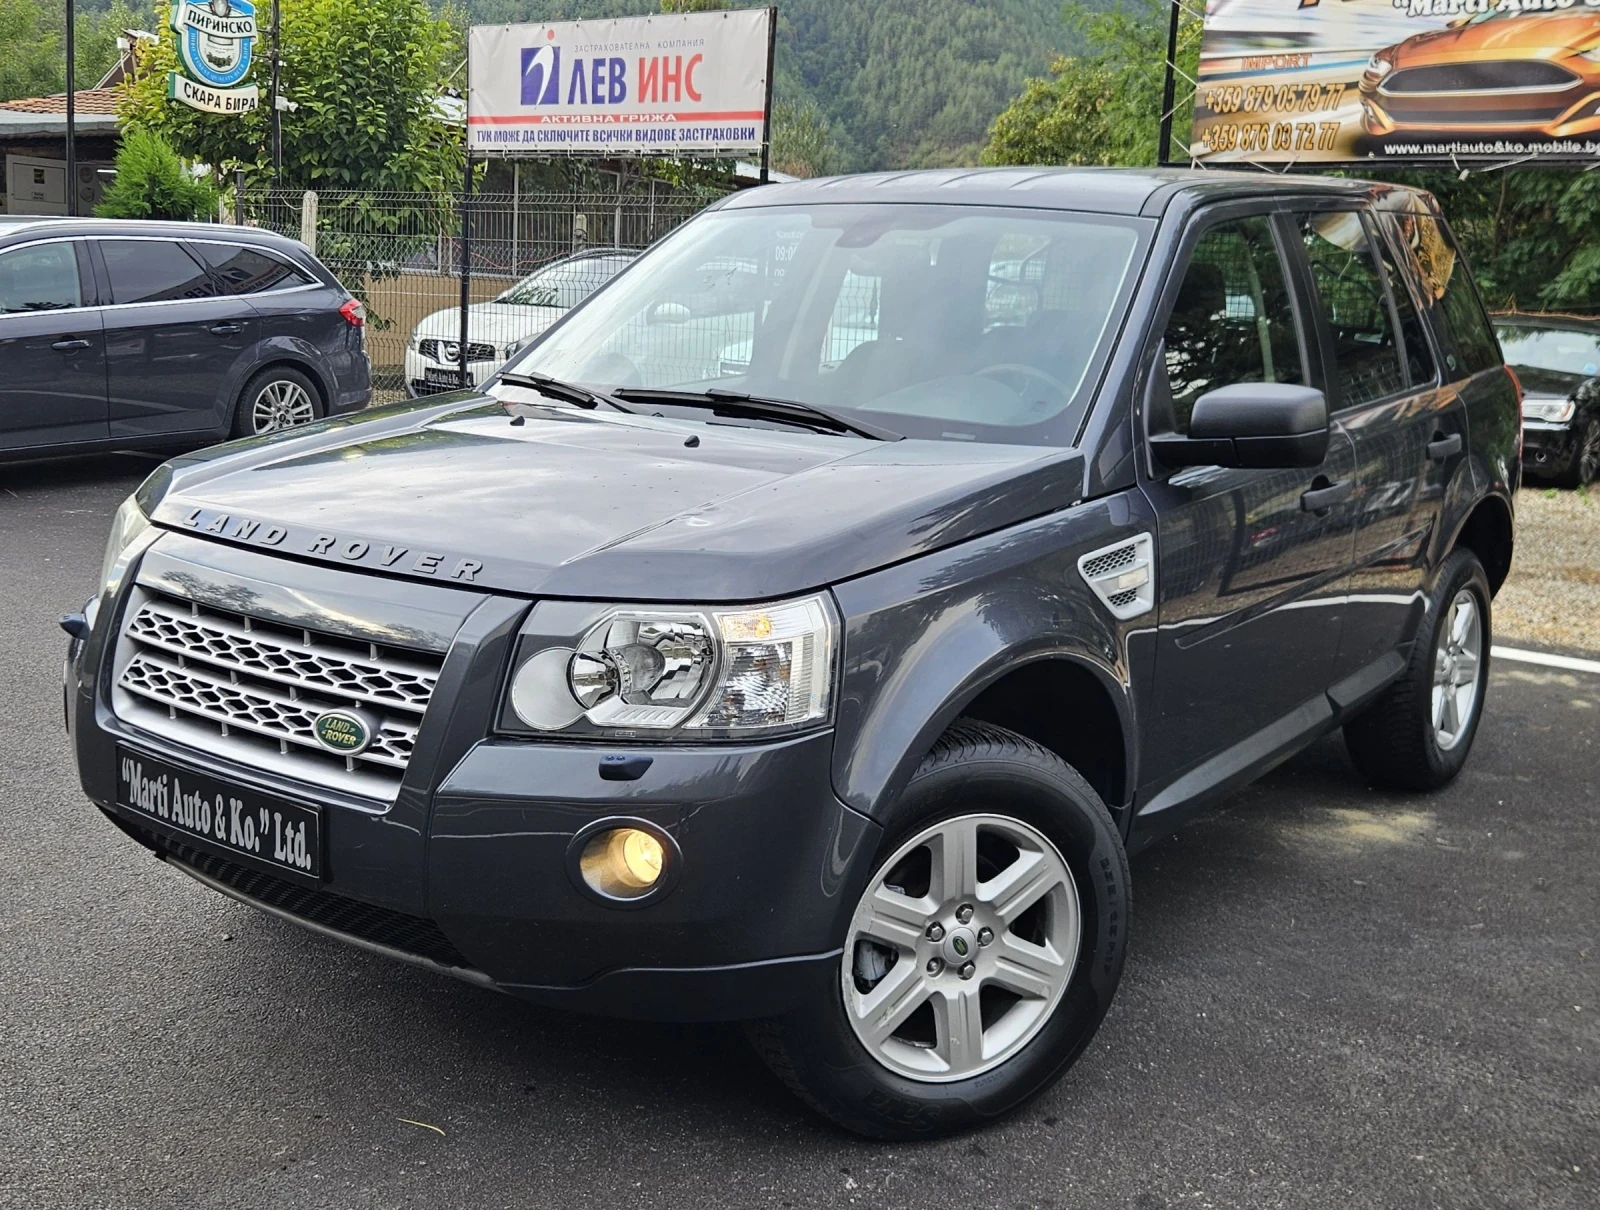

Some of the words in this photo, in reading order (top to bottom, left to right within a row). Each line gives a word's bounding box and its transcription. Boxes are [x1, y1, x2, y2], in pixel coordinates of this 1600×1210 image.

[187, 10, 253, 34] ПИРИНСКО
[574, 42, 650, 53] ЗАСТРАХОВАТЕЛНА
[657, 38, 705, 49] КОМПАНИЯ
[1241, 53, 1312, 71] IMPORT
[567, 57, 627, 105] ЛЕВ
[638, 53, 703, 104] ИНС
[183, 81, 221, 109] СКАРА
[225, 97, 256, 111] БИРА
[1205, 85, 1243, 114] +359
[1244, 85, 1275, 113] 879
[1276, 84, 1300, 113] 05
[1299, 83, 1321, 112] 79
[1323, 82, 1347, 111] 77
[541, 115, 615, 124] АКТИВНА
[619, 113, 677, 123] ГРИЖА
[477, 130, 492, 143] ТУК
[494, 130, 520, 143] МОЖЕ
[522, 130, 535, 144] ДА
[537, 129, 590, 143] СКЛЮЧИТЕ
[592, 128, 633, 142] ВСИЧКИ
[635, 128, 677, 144] ВИДОВЕ
[679, 127, 756, 142] ЗАСТРАХОВКИ
[1201, 122, 1238, 151] +359
[1240, 122, 1270, 151] 876
[1272, 122, 1292, 151] 03
[1295, 121, 1316, 150] 72
[1318, 121, 1341, 150] 77
[182, 508, 288, 546] LAND
[306, 532, 484, 581] ROVER
[325, 718, 350, 733] LAND
[325, 730, 357, 746] ROVER
[122, 757, 168, 819] “Marti
[171, 777, 211, 834] Auto
[215, 793, 227, 841] &
[230, 797, 270, 853] Ko.”
[273, 812, 312, 871] Ltd.
